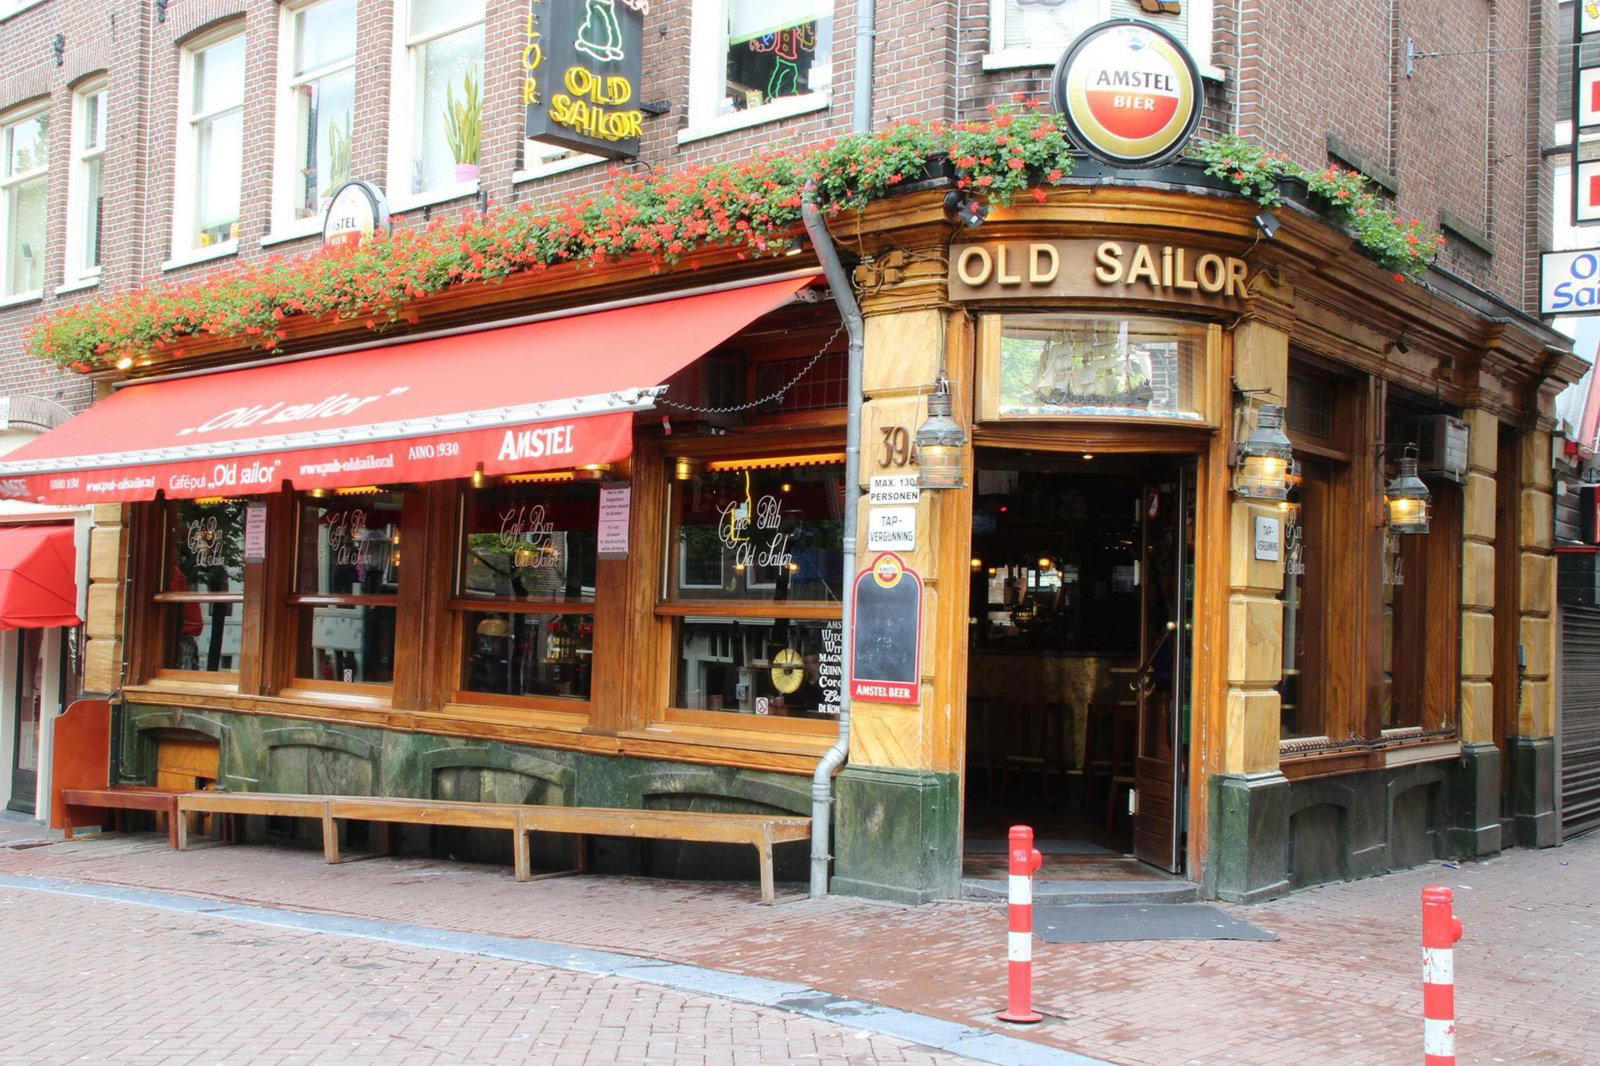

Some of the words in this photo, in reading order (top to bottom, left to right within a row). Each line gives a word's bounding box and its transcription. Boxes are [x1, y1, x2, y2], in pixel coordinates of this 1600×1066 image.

[565, 66, 632, 105] OLD
[1096, 70, 1173, 92] AMSTEL
[1113, 95, 1155, 111] BIER
[548, 93, 643, 141] SAILOR
[957, 243, 1060, 286] OLD
[408, 445, 434, 461] ANNO
[436, 441, 459, 456] 1930
[497, 424, 574, 461] AMSTEL
[874, 479, 897, 488] MAX.
[870, 491, 918, 501] PERSONEN
[757, 495, 781, 531] Pub
[881, 516, 902, 527] TAP-
[869, 531, 914, 542] VERGUNNING
[736, 540, 756, 567] Old
[758, 533, 793, 575] Sailor
[855, 685, 887, 697] AMSTEL
[888, 687, 911, 699] BEER
